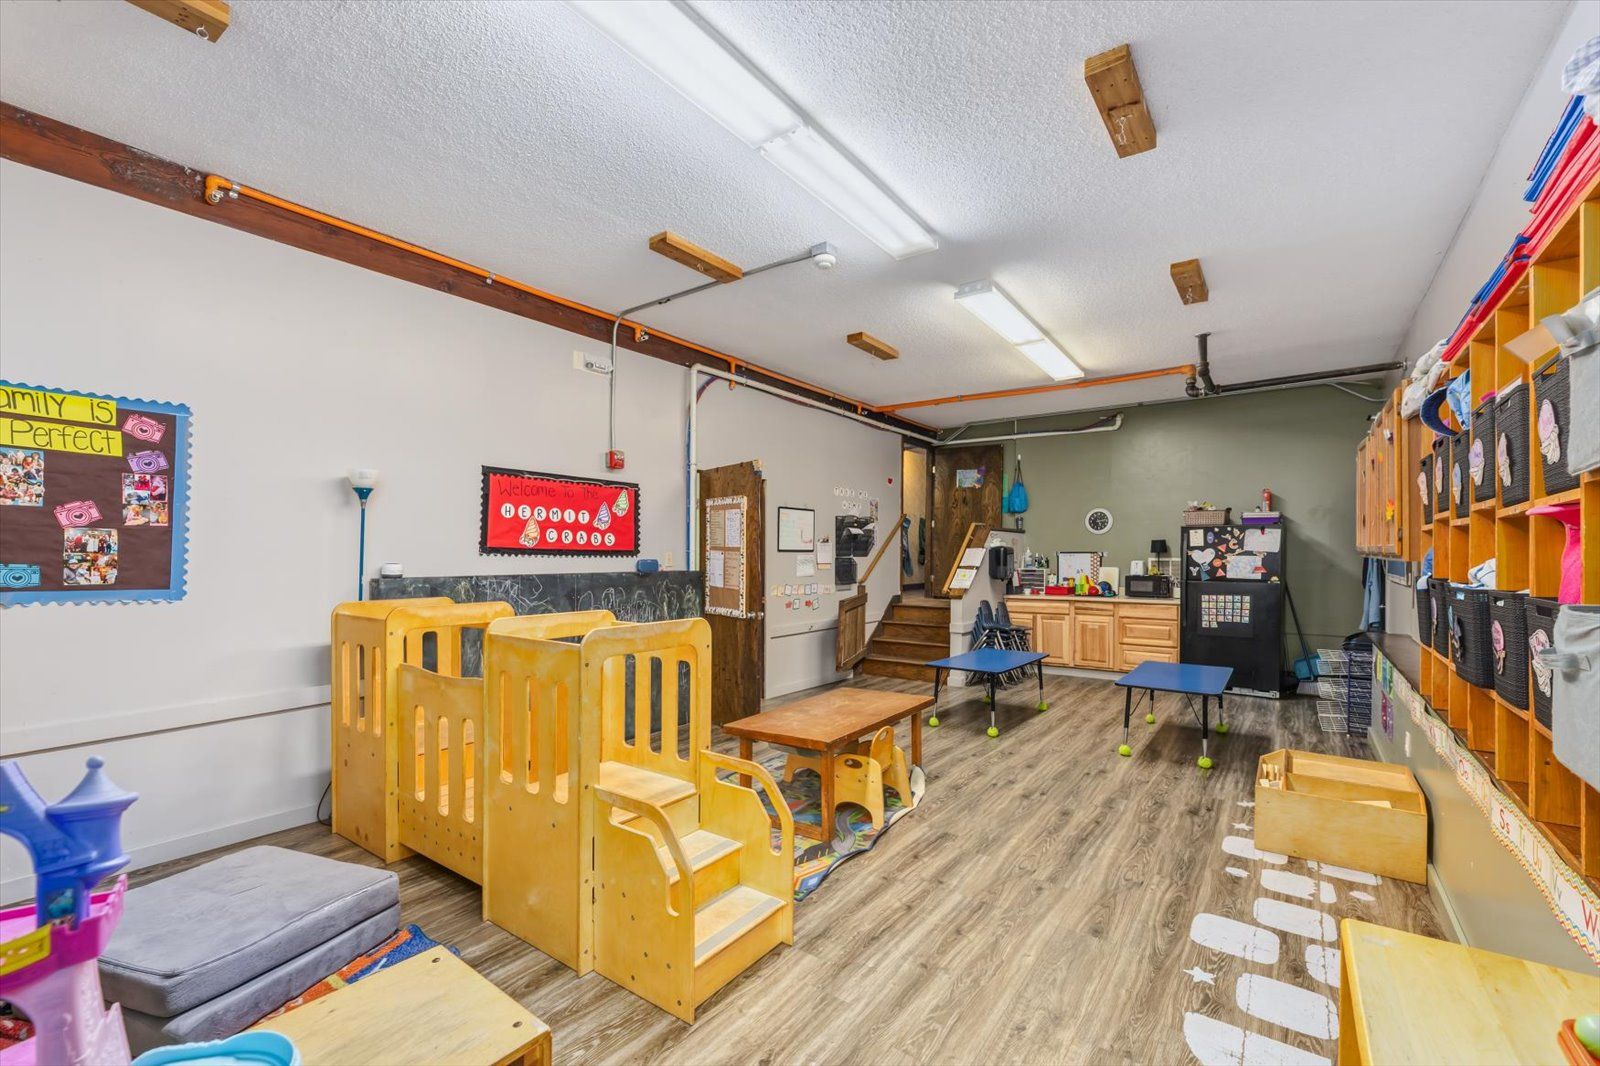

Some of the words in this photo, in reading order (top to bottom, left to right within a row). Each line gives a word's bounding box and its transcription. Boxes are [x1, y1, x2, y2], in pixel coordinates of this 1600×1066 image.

[90, 400, 114, 424] is
[10, 419, 116, 454] Perfect
[498, 480, 556, 497] Welcome
[582, 486, 599, 499] The
[504, 506, 586, 522] HERMIT
[548, 530, 613, 545] CRABS
[1500, 808, 1511, 834] Ss
